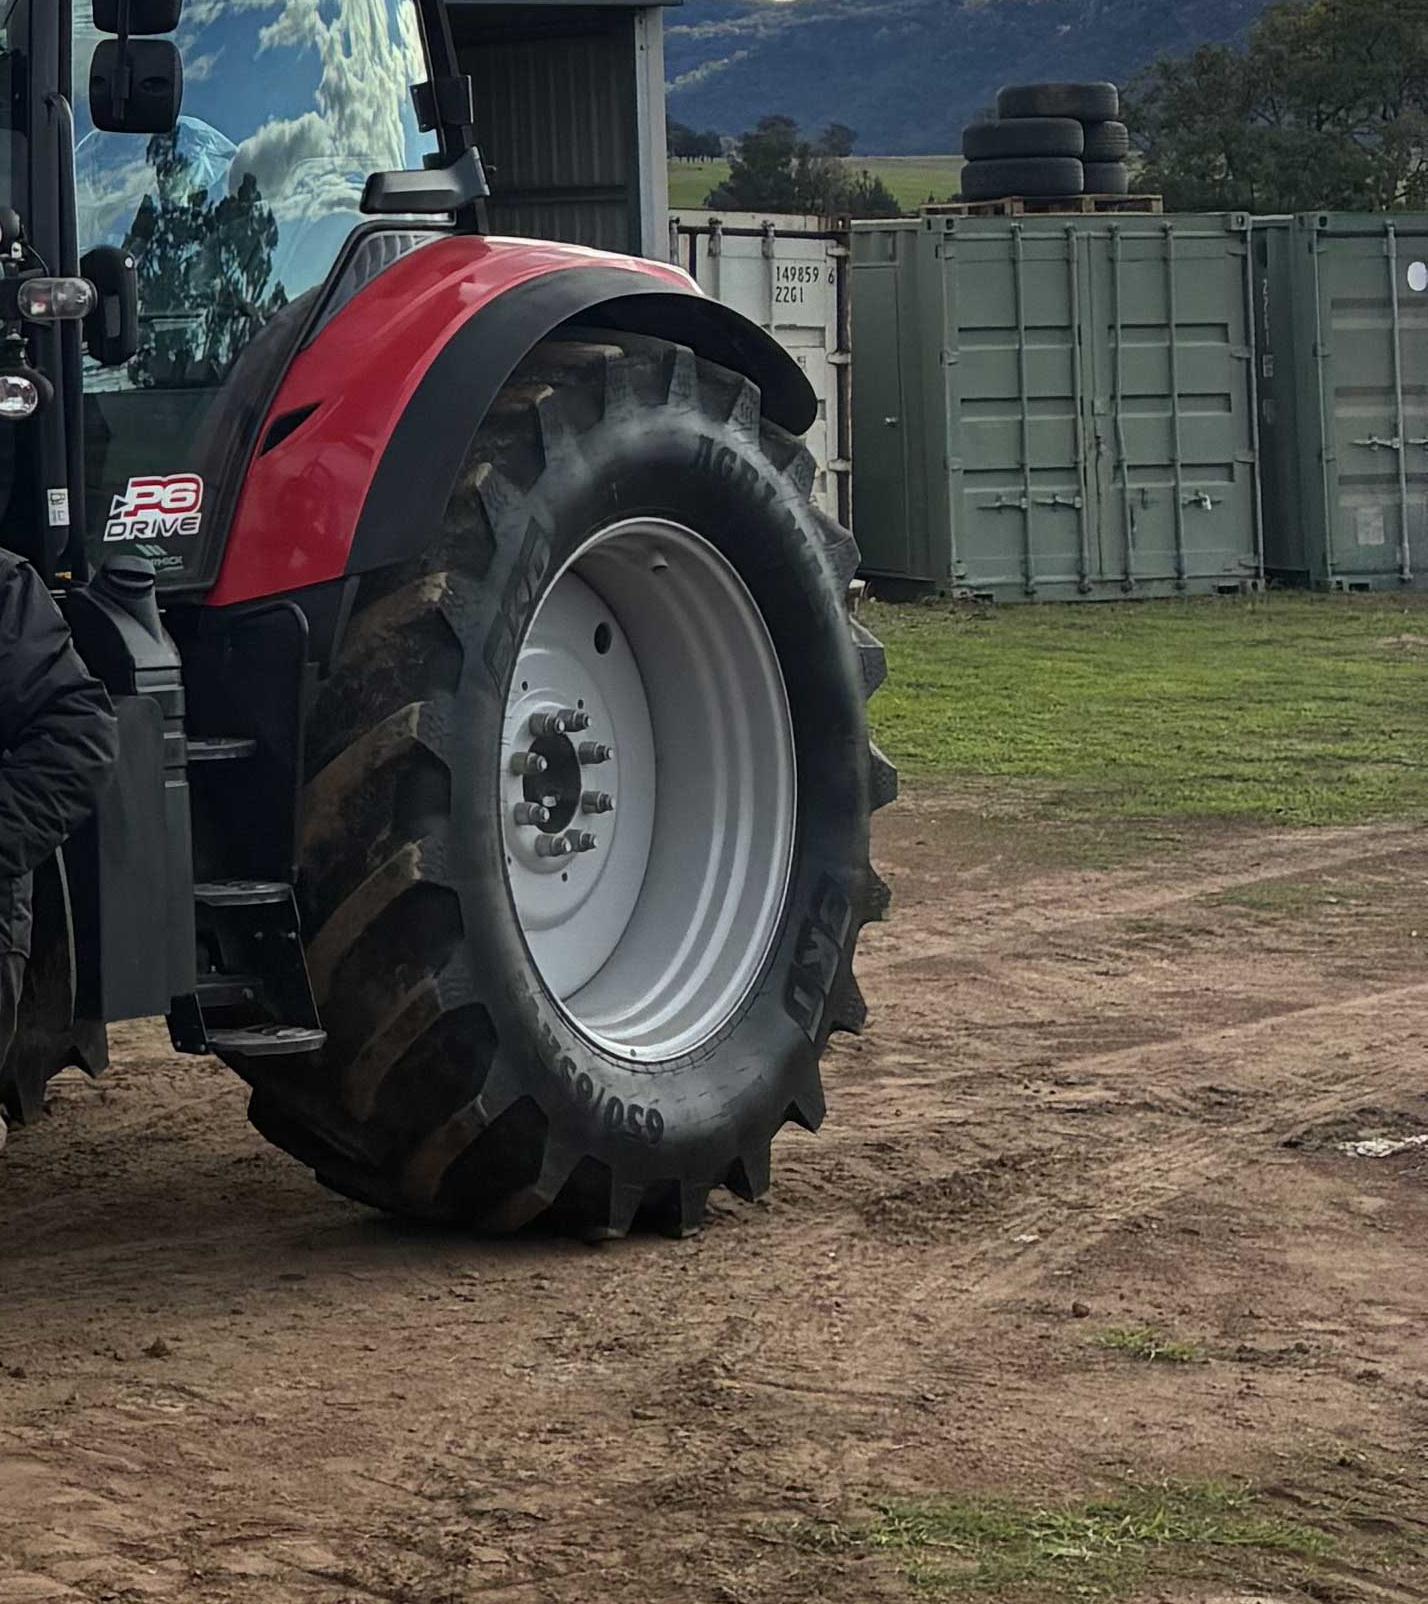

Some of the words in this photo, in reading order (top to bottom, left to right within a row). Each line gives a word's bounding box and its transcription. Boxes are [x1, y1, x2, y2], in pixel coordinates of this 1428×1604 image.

[775, 265, 820, 284] 149859
[123, 477, 201, 515] P6
[105, 514, 201, 540] DRIVE
